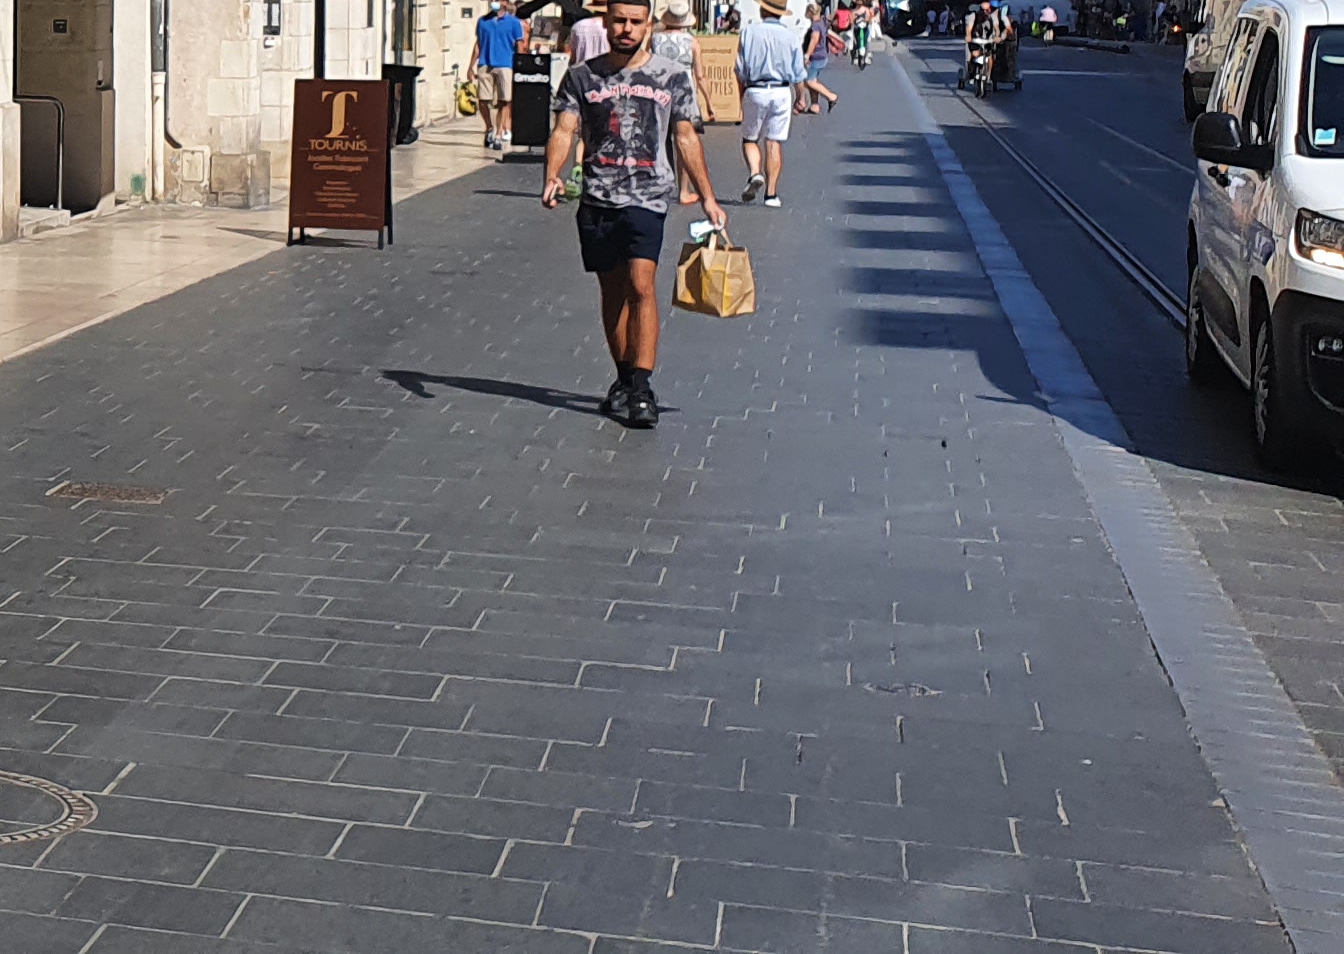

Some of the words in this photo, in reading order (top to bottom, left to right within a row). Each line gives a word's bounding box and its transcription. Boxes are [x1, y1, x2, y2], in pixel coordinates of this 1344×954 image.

[707, 66, 732, 80] NIQUE
[709, 80, 734, 96] TYLES
[309, 139, 368, 152] TOURNIS
